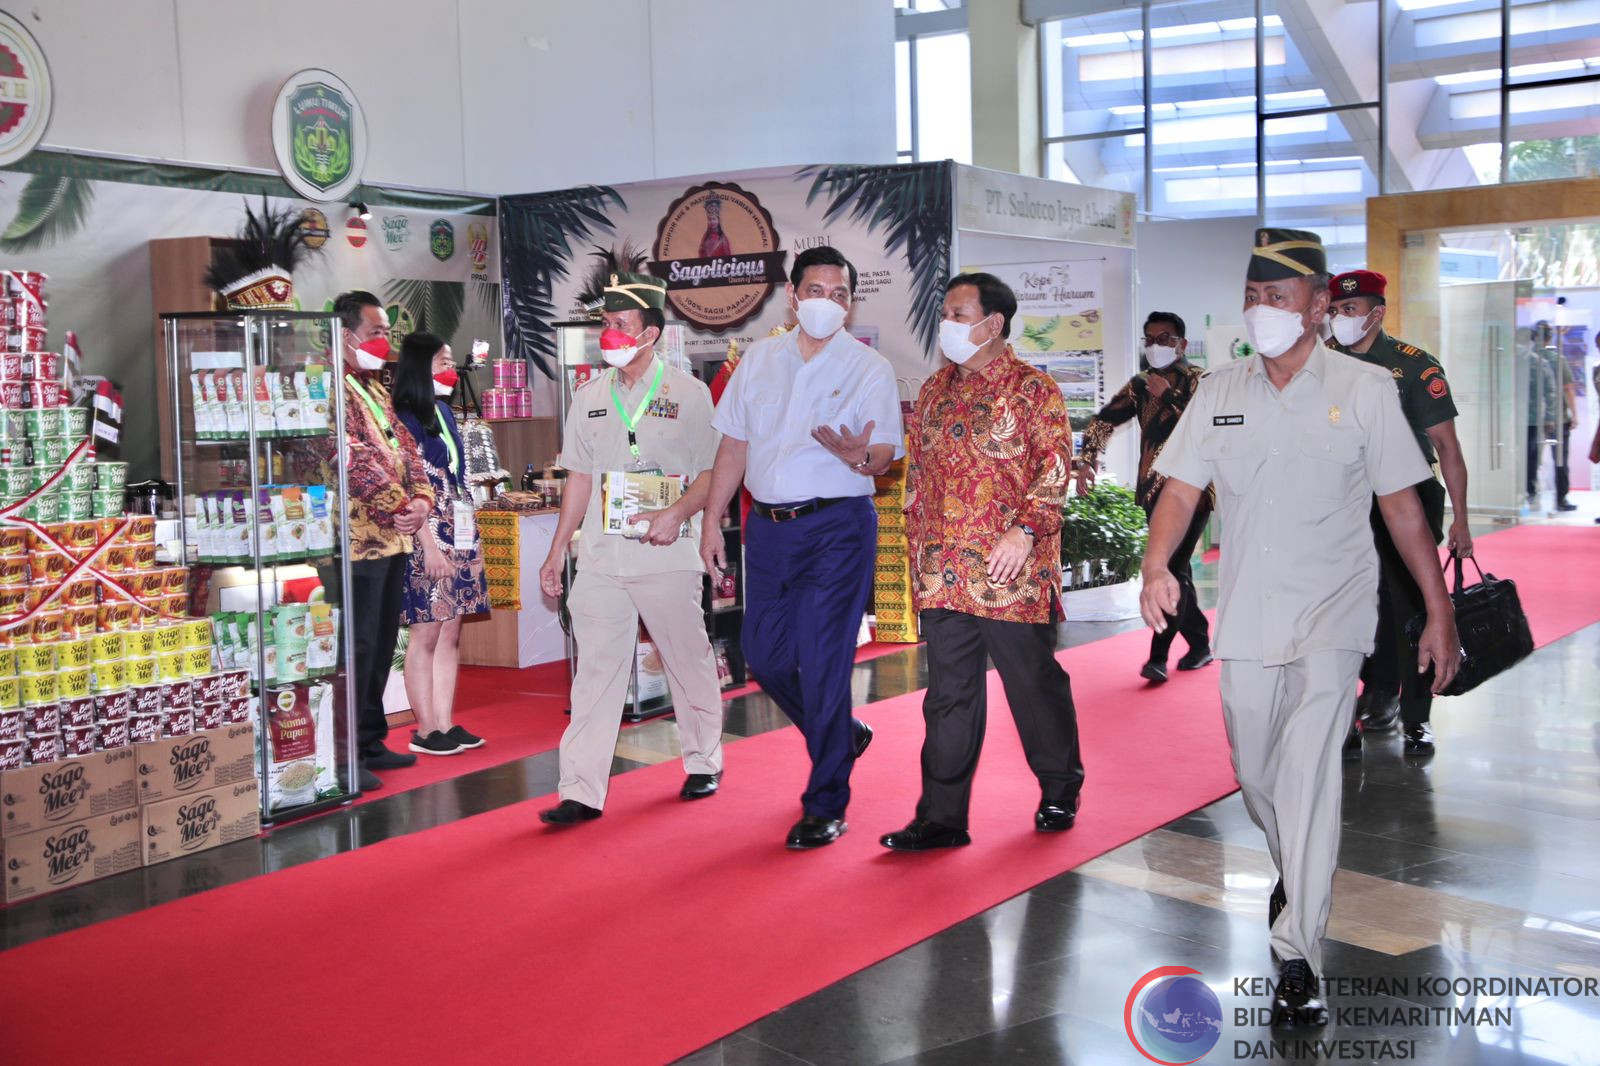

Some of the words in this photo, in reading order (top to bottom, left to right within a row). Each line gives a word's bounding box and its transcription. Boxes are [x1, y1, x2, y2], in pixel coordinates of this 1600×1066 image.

[669, 257, 766, 286] Sagolicious
[170, 740, 210, 765] Sago
[39, 766, 85, 794] Sago
[173, 760, 205, 784] Mee
[44, 787, 79, 814] Mee
[176, 799, 217, 826] Sago
[43, 829, 90, 859] Sago
[180, 820, 211, 844] Mee
[48, 850, 83, 878] Mee
